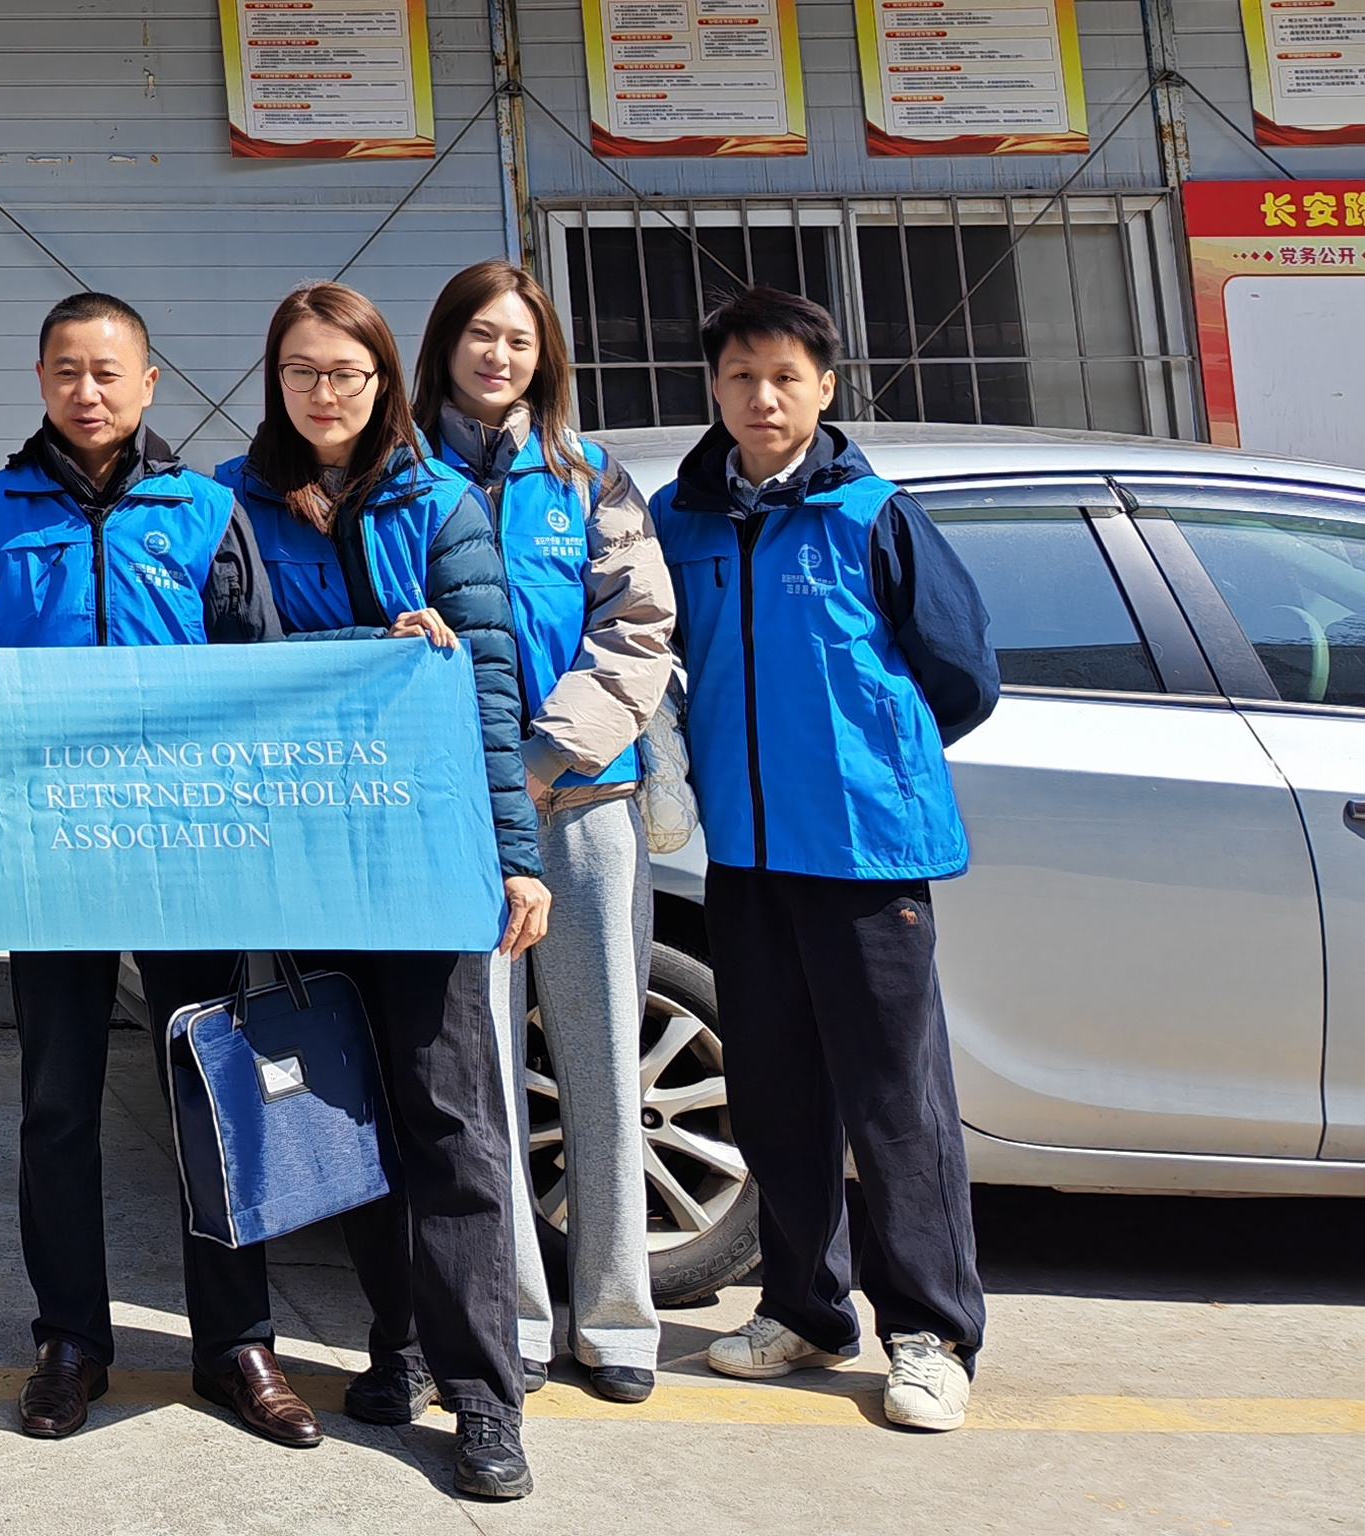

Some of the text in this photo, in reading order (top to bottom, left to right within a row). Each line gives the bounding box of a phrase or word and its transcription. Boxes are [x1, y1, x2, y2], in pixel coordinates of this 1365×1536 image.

[1260, 192, 1365, 228] 长安路
[1279, 247, 1356, 265] 党务公开
[42, 739, 388, 769] LUOYANG OVERSEAS
[45, 780, 412, 810] RETURNED SCHOLARS
[50, 822, 271, 851] ASSOCIATION
